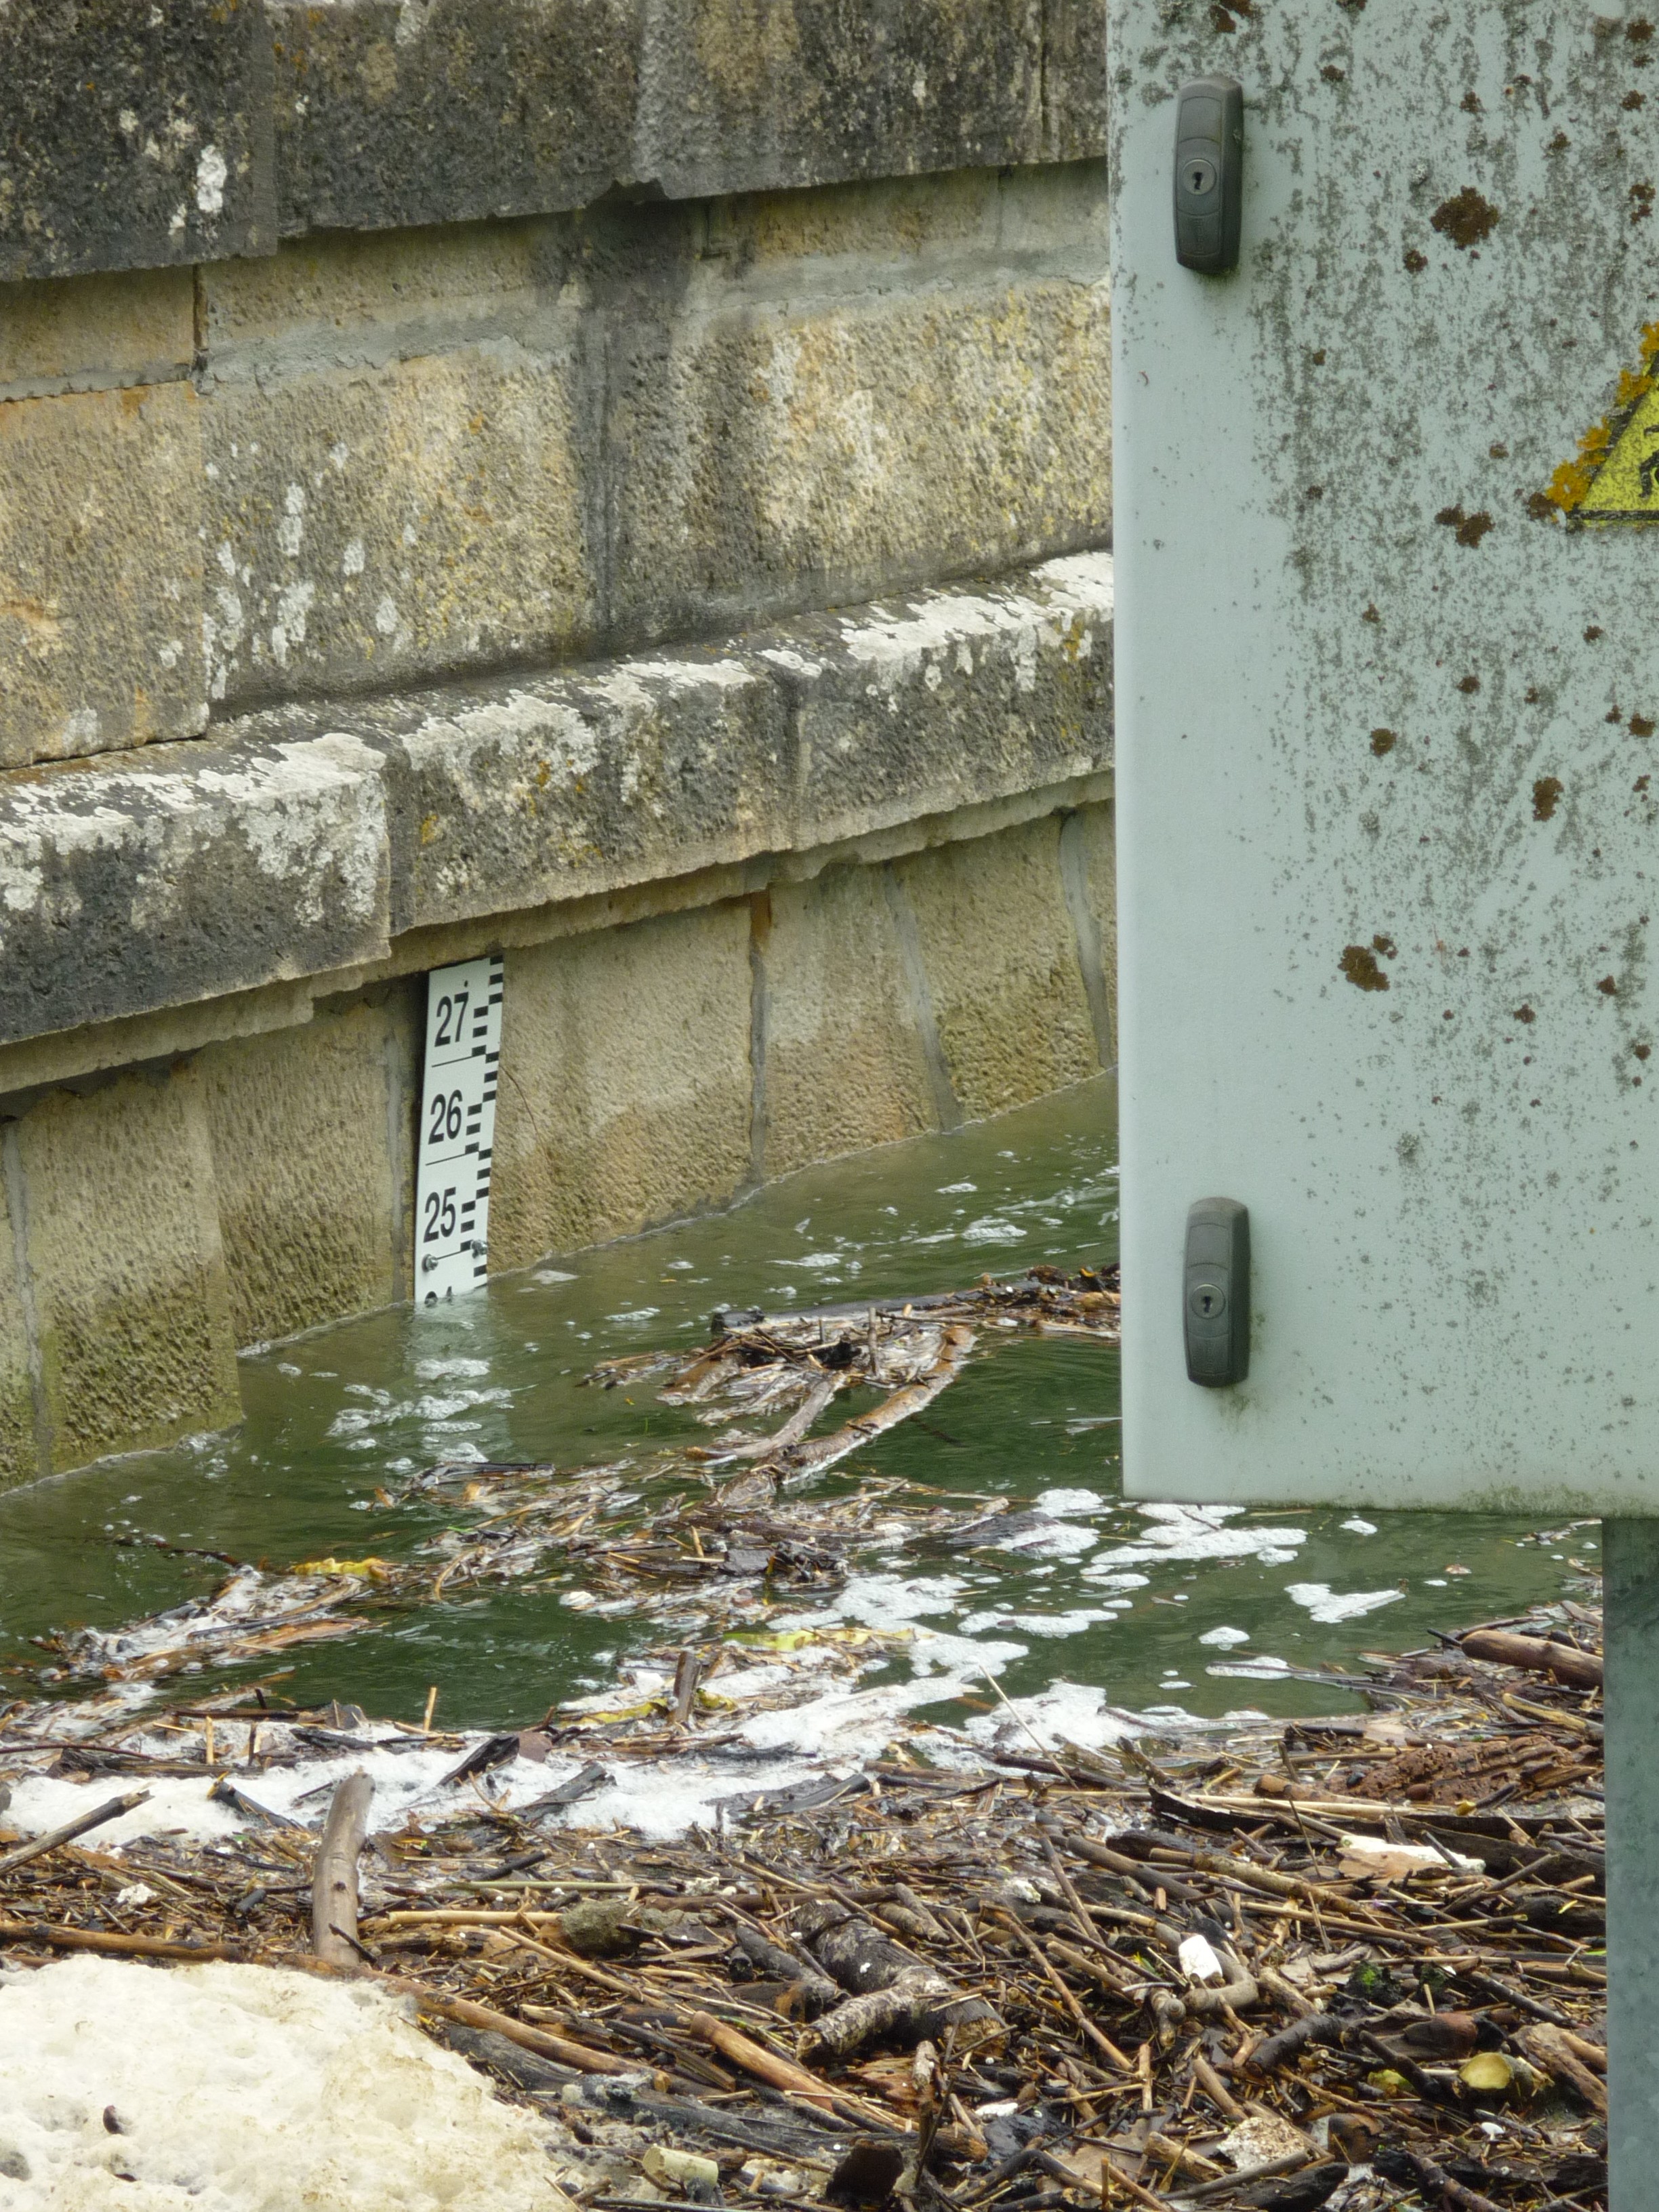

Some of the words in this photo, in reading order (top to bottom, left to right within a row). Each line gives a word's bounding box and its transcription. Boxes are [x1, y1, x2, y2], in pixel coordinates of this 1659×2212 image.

[434, 991, 470, 1047] 27
[428, 1090, 463, 1145] 26
[424, 1187, 456, 1243] 25
